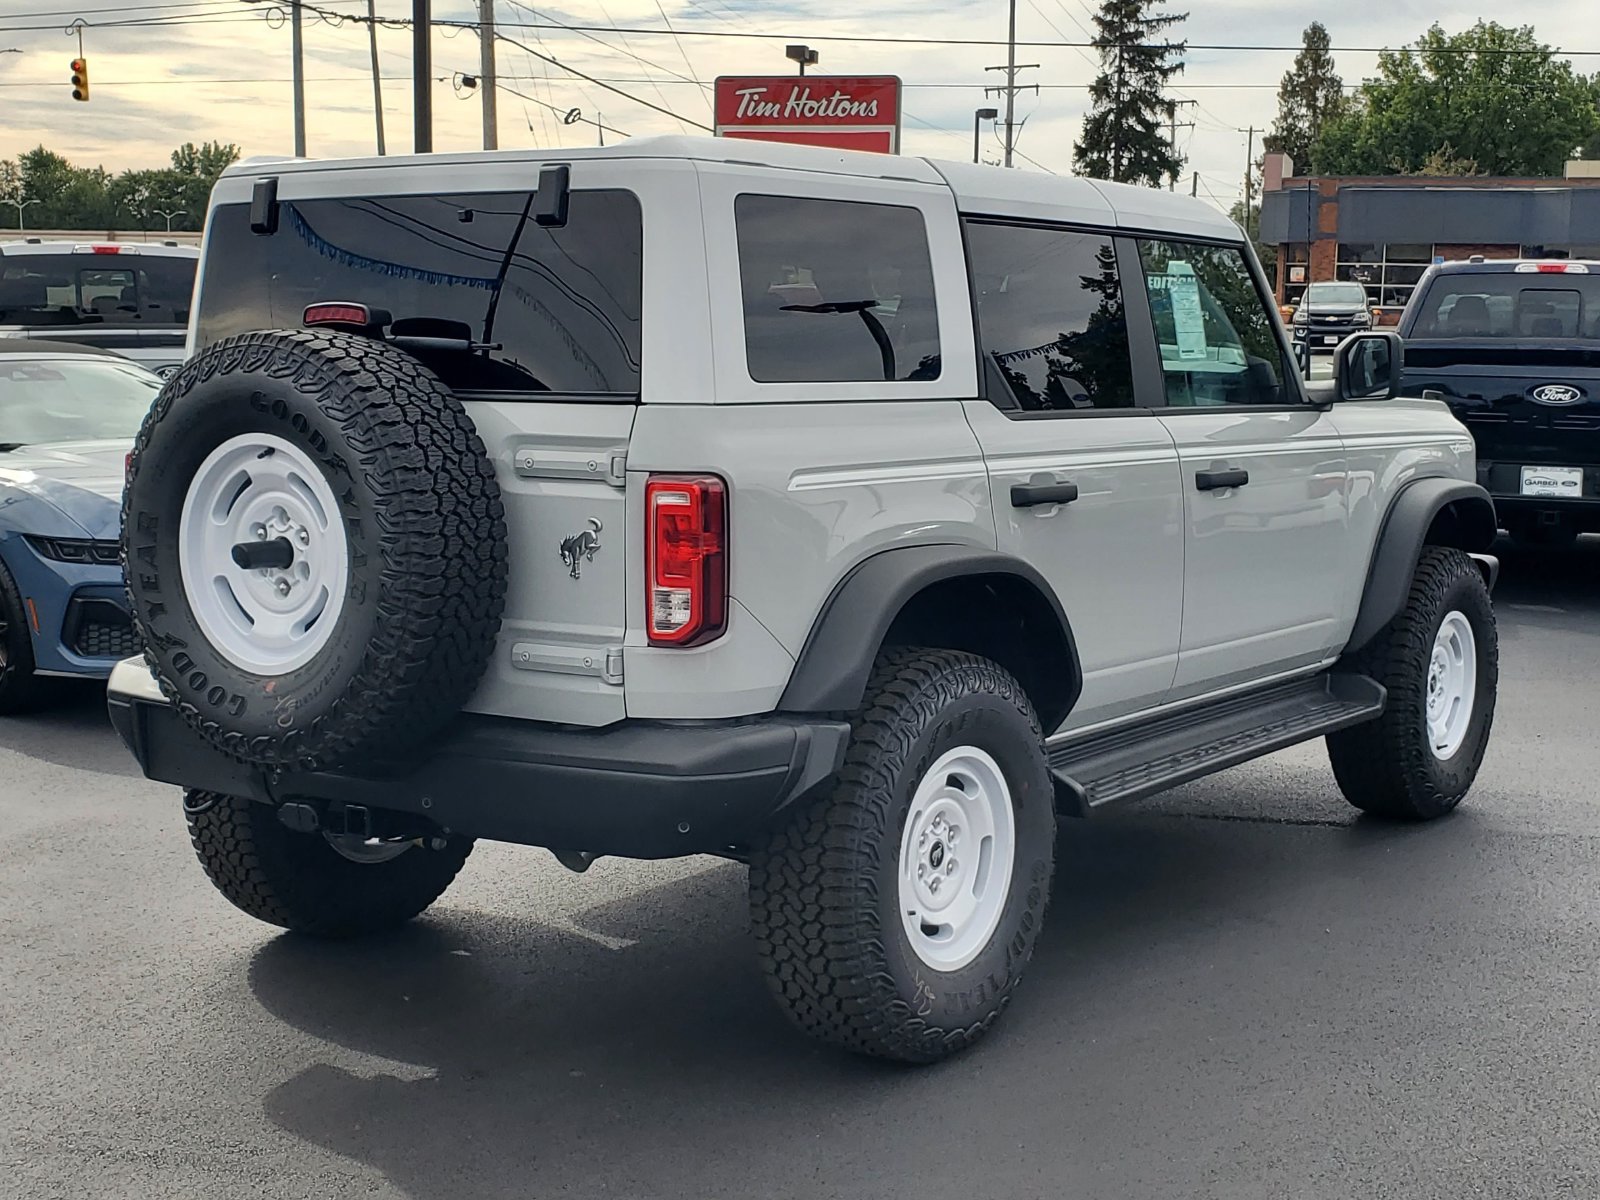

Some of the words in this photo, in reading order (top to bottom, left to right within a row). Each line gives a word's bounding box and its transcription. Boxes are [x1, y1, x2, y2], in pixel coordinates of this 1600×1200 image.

[735, 87, 779, 119] Tim
[784, 85, 878, 118] Hortons
[1147, 275, 1196, 290] EDIT
[1540, 387, 1573, 402] Ford
